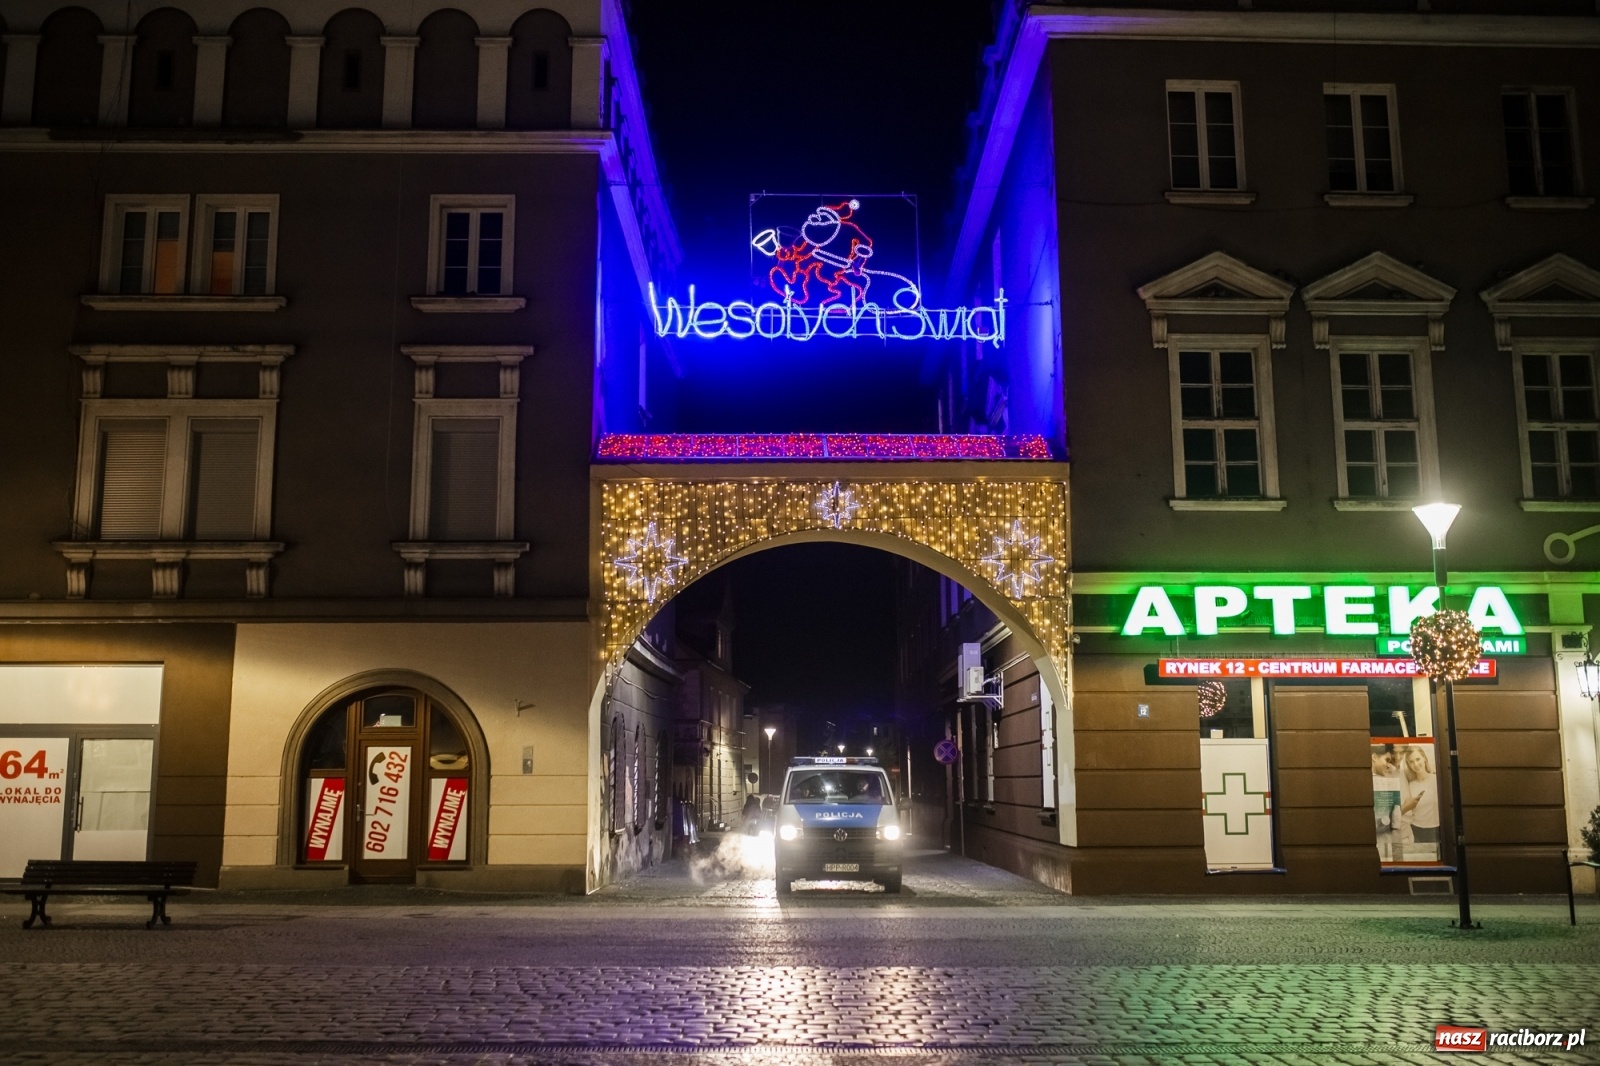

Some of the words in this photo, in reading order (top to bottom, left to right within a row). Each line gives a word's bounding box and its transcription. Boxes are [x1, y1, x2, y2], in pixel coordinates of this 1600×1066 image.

[1121, 586, 1525, 636] APTEKA
[1165, 662, 1222, 674] RYNEK
[1225, 662, 1245, 674] 12
[1258, 662, 1337, 674] CENTRUM
[45, 787, 62, 795] DO
[309, 787, 345, 849] WYNAJMĘ
[366, 820, 390, 853] 602
[384, 750, 408, 784] 432
[432, 787, 467, 849] WYNAJMĘ
